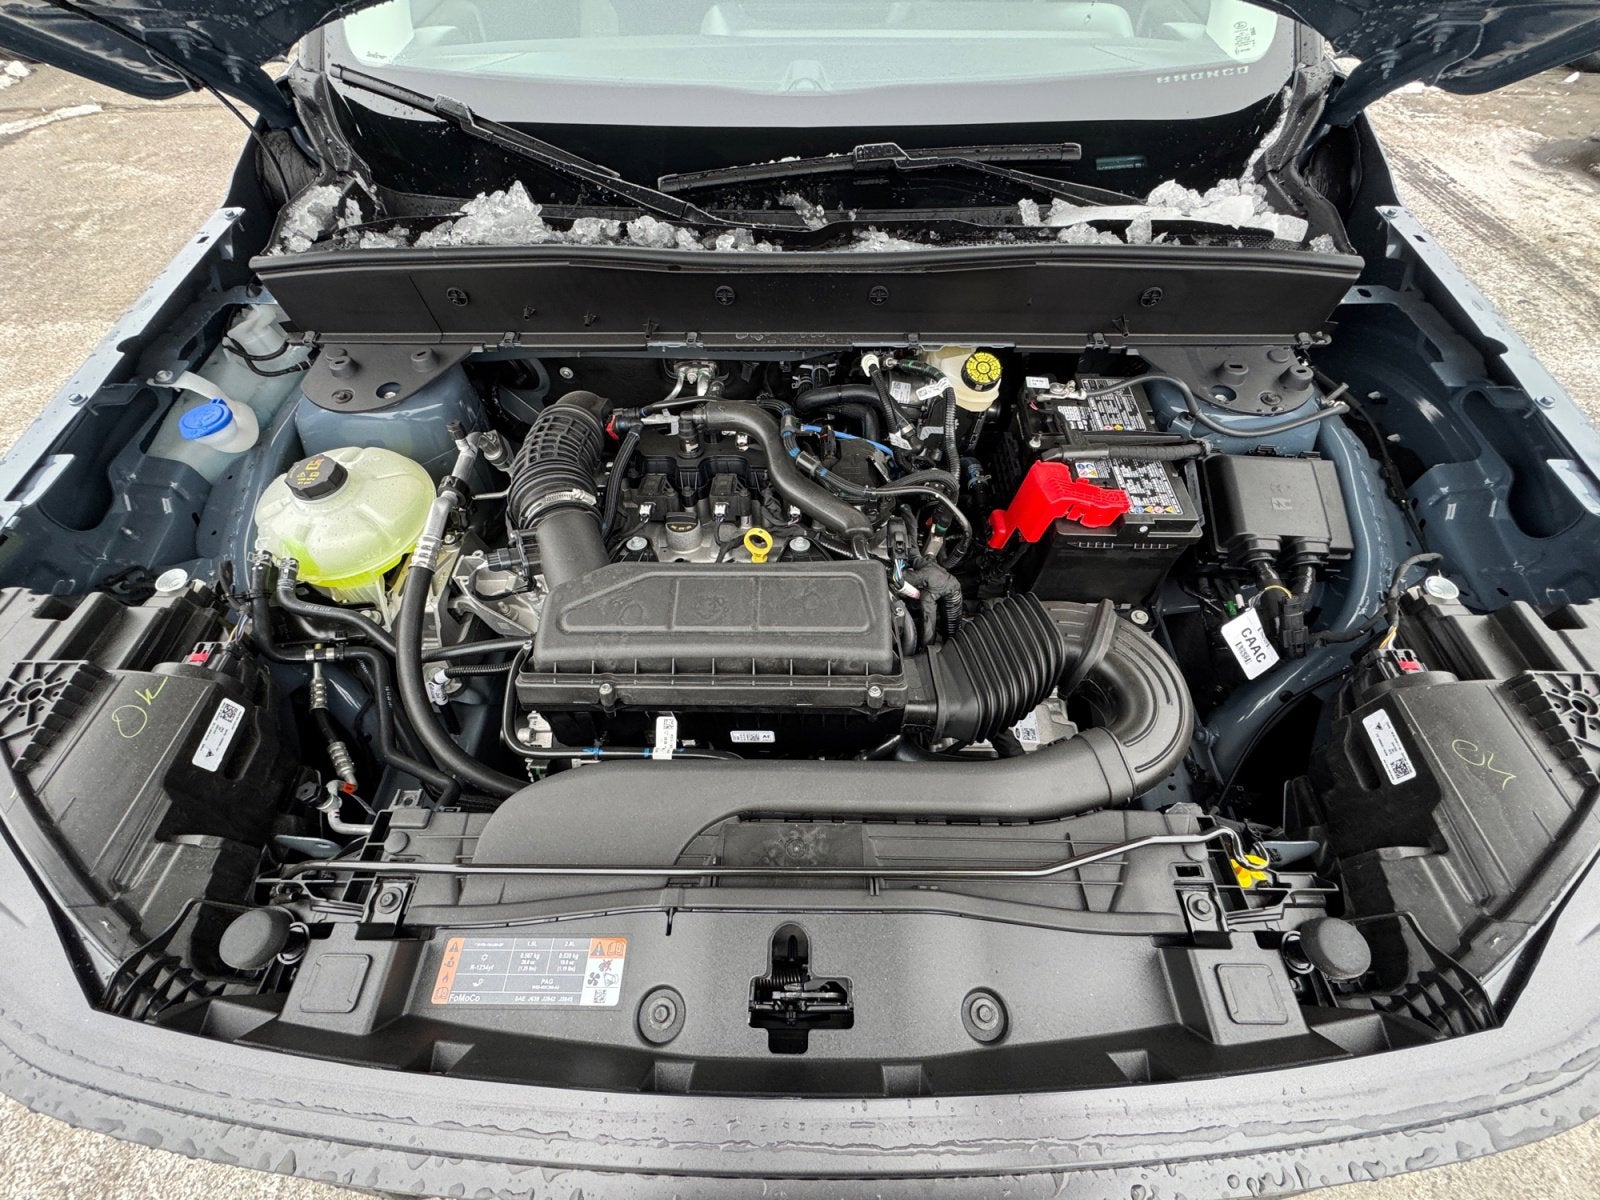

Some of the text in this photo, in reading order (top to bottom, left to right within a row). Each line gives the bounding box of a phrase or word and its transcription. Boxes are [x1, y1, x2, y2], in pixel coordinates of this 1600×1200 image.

[1241, 627, 1267, 663] CAAC
[533, 952, 541, 960] kg
[572, 952, 579, 960] kg
[469, 964, 495, 972] R-1234yf
[448, 994, 481, 1002] FoMoCo
